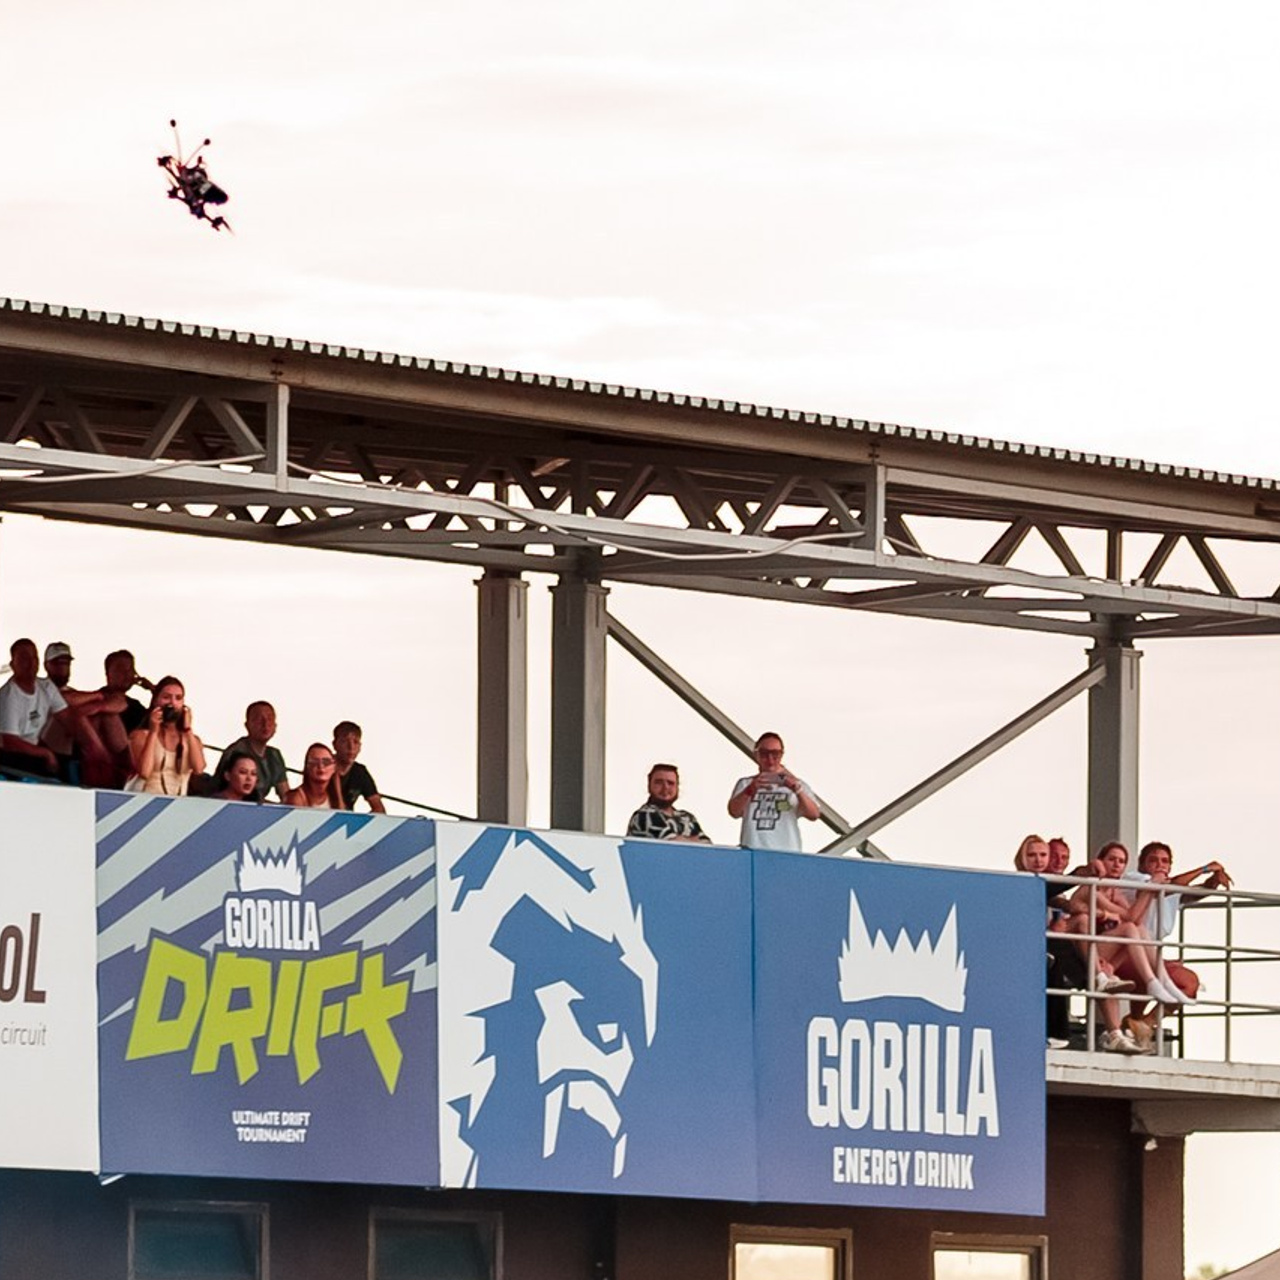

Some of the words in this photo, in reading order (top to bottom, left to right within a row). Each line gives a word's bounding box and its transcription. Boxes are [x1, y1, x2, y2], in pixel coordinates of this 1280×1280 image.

[225, 899, 319, 951] GORILLA
[0, 1021, 47, 1046] circuit
[125, 936, 411, 1095] DRIFT
[807, 1015, 1000, 1138] GORILLA
[232, 1110, 280, 1126] ULTIMATE
[281, 1111, 311, 1127] DRIFT
[236, 1127, 307, 1143] TOURNAMENT
[833, 1146, 911, 1187] ENERGY
[914, 1151, 974, 1191] DRINK
